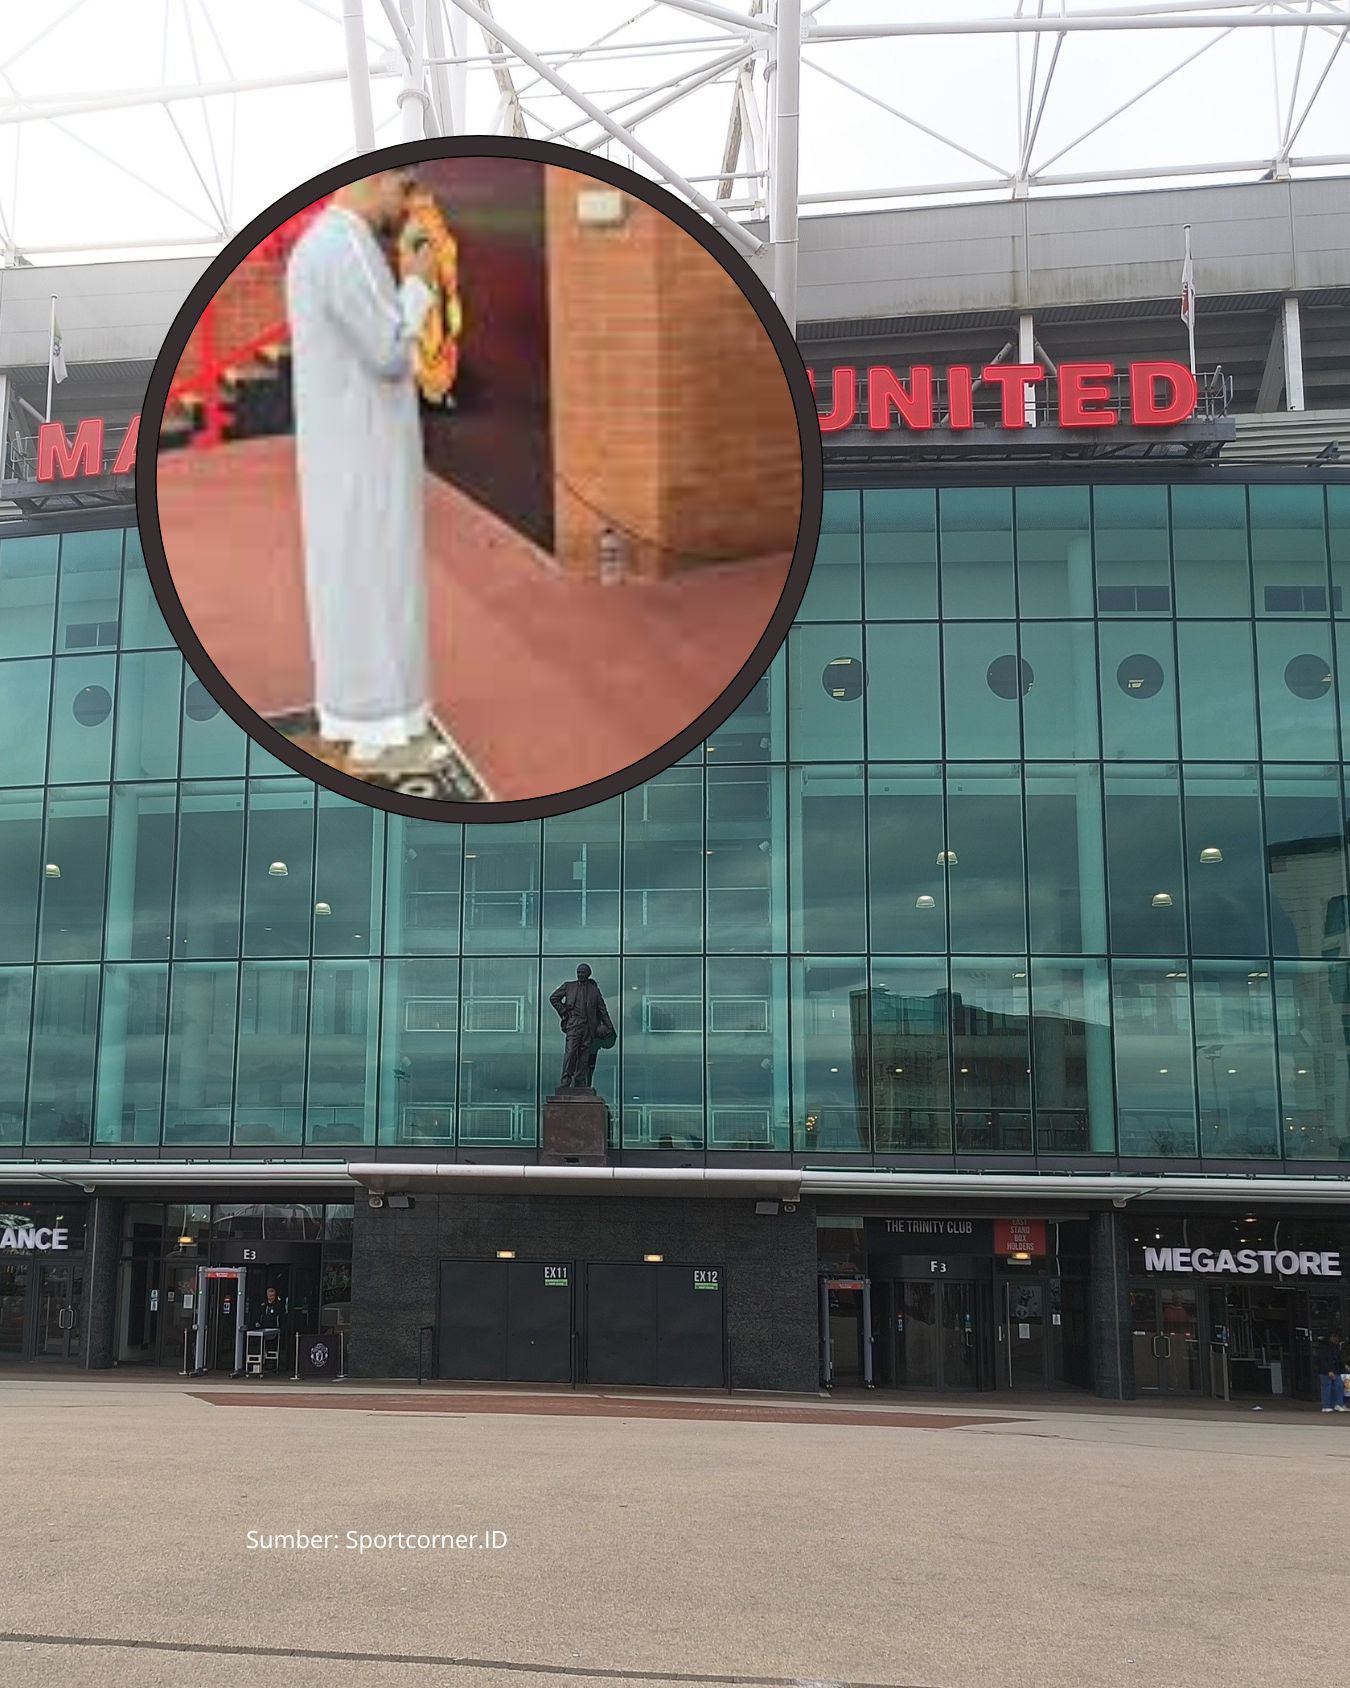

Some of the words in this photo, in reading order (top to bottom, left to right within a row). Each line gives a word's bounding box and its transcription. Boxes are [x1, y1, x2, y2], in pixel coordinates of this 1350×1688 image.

[806, 361, 1197, 433] UNITED
[886, 1220, 905, 1232] THE
[906, 1220, 945, 1233] TRINITY
[947, 1221, 973, 1233] CLUB
[1010, 1225, 1031, 1234] STAND
[0, 1227, 69, 1250] ANCE
[1013, 1234, 1027, 1242] BOX
[1007, 1242, 1035, 1251] HOLDERS
[243, 1249, 257, 1260] E3
[1144, 1247, 1342, 1276] MEGASTORE
[544, 1266, 567, 1279] EX11
[694, 1270, 718, 1283] EX12
